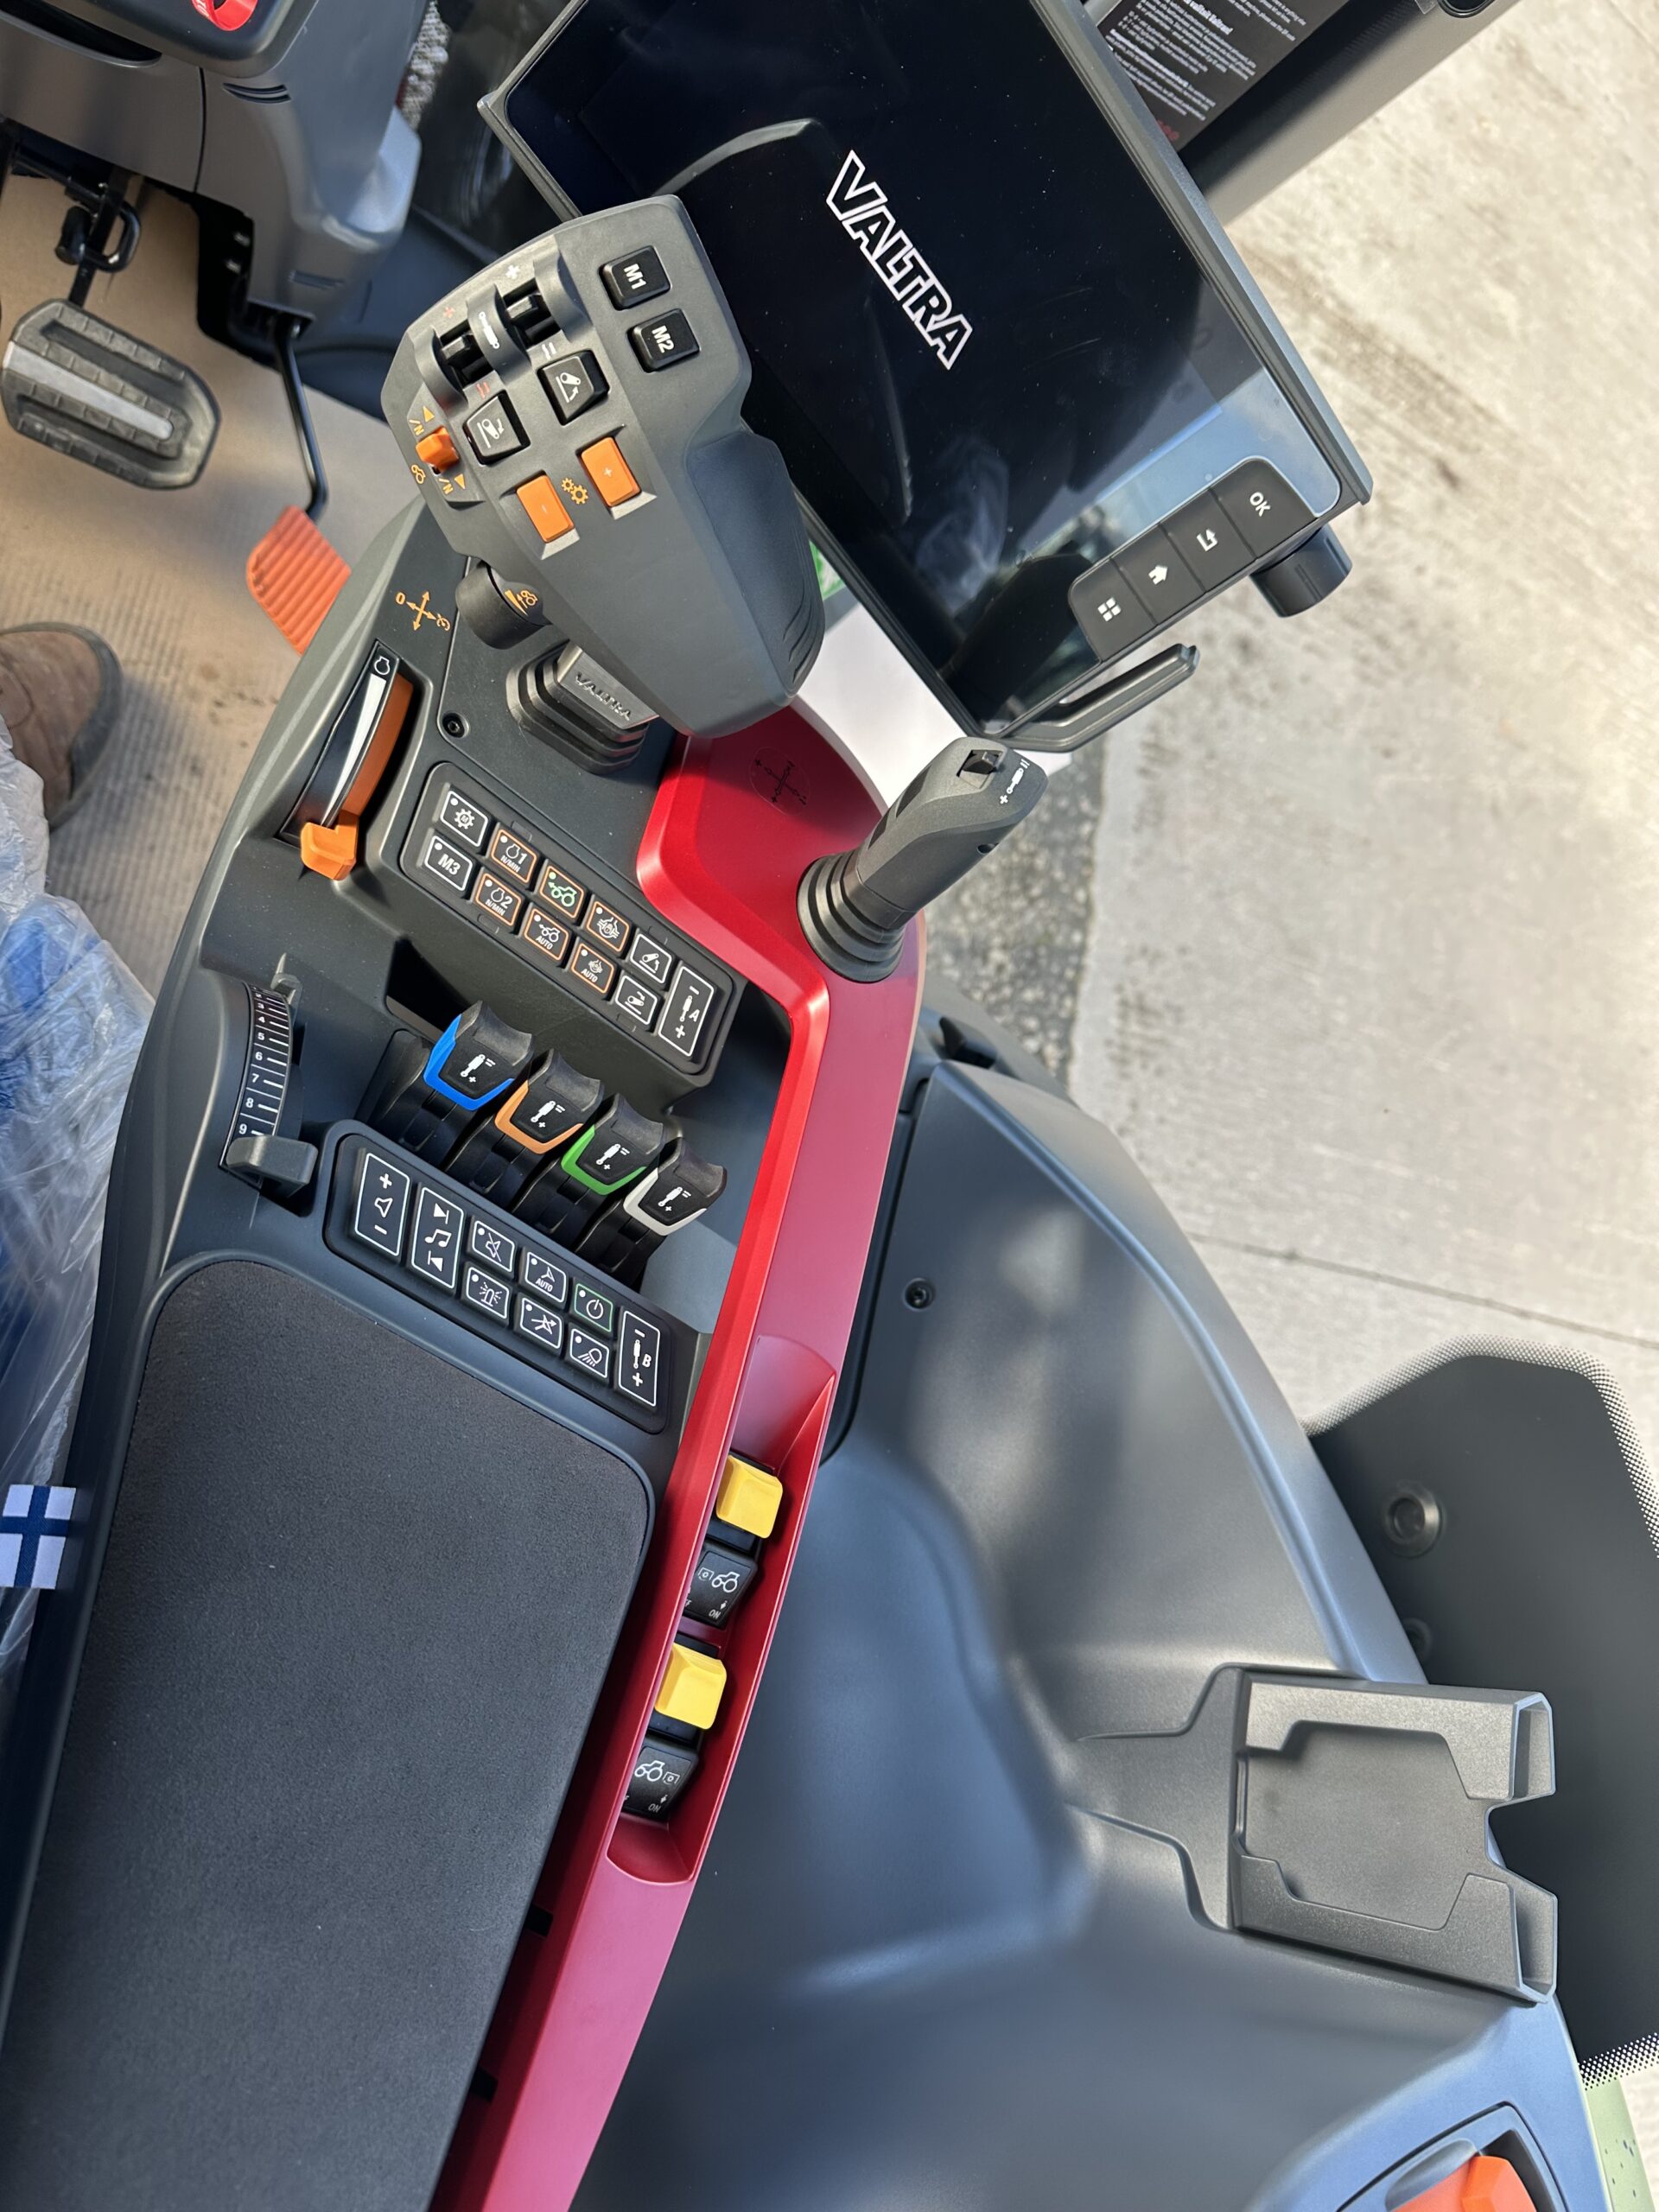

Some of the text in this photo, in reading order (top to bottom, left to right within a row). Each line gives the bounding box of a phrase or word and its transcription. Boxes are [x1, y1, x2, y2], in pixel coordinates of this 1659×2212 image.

[826, 149, 973, 371] VALTRA
[623, 263, 646, 289] M1
[652, 325, 675, 353] M2
[1249, 492, 1271, 517] OK
[575, 671, 631, 721] VALTRA
[437, 853, 461, 875] M3
[500, 855, 521, 873] N/MIN
[485, 899, 505, 916] N/MIN
[501, 895, 513, 909] 2
[535, 935, 554, 950] AUTO
[581, 968, 599, 983] AUTO
[689, 1009, 700, 1022] A
[257, 1032, 265, 1040] 5
[255, 1051, 263, 1061] 6
[251, 1073, 260, 1084] 7
[245, 1098, 254, 1109] 8
[238, 1123, 247, 1135] 9
[535, 1277, 554, 1293] AUTO
[642, 1353, 652, 1368] B
[709, 1609, 721, 1619] ON
[648, 1803, 661, 1813] ON
